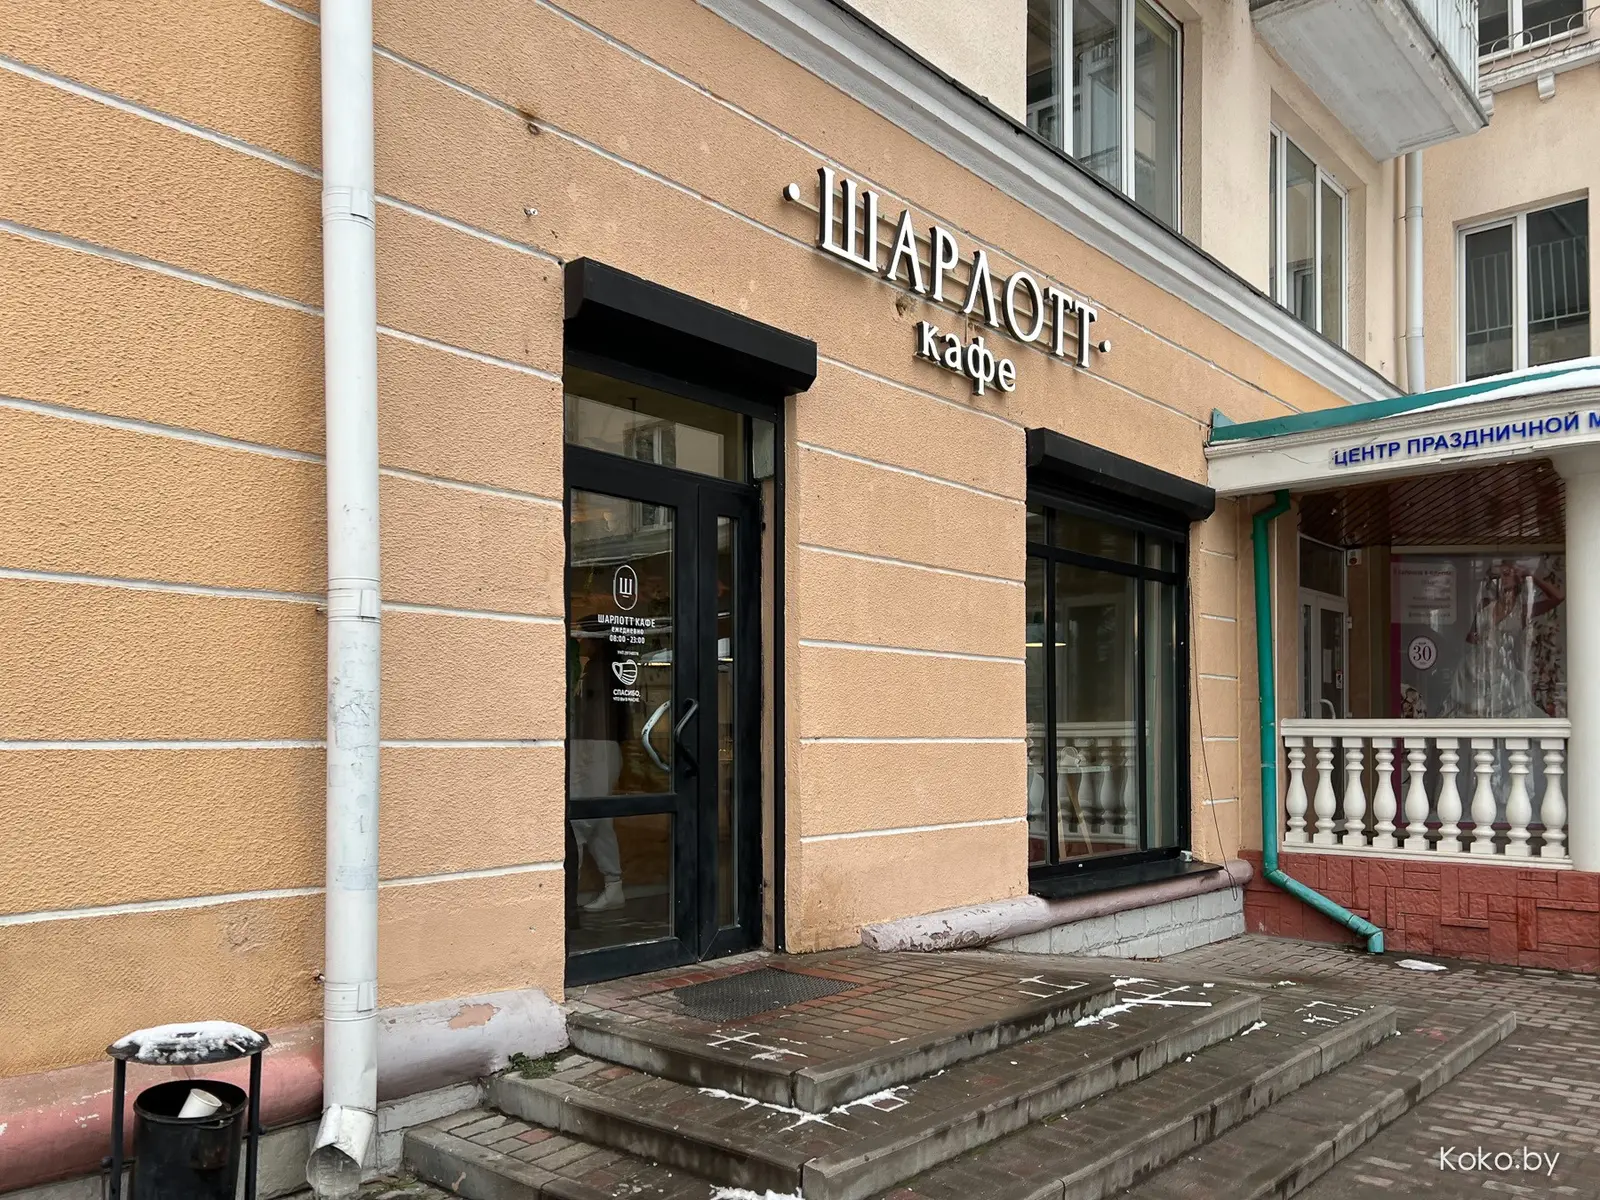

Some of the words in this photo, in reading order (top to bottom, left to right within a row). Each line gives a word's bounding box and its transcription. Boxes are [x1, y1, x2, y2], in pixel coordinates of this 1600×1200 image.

[816, 166, 1098, 370] ШАРЛОТТ
[915, 320, 1016, 396] кафе
[1334, 441, 1401, 466] ЦЕНТР
[1407, 411, 1579, 455] ПРАЗДНИЧНОЙ
[619, 577, 632, 595] Ш
[597, 613, 634, 626] ШАРЛОТТ
[635, 617, 656, 628] КАФЕ
[609, 634, 626, 643] 08:00
[630, 636, 646, 644] 23:00
[1413, 645, 1432, 661] 30
